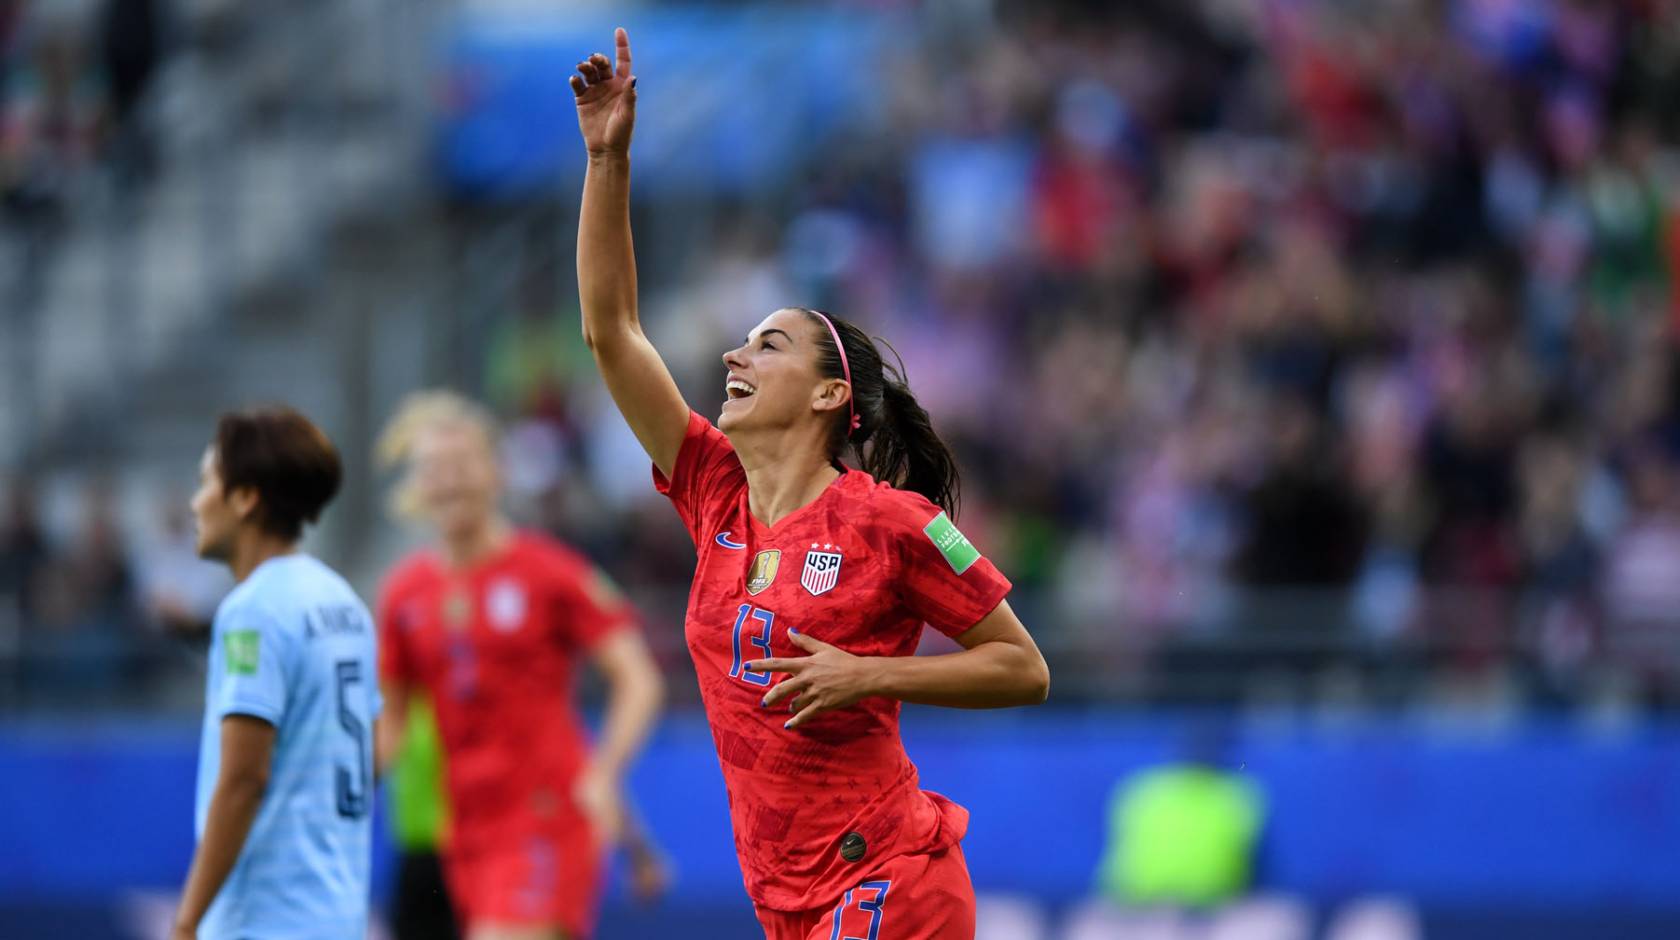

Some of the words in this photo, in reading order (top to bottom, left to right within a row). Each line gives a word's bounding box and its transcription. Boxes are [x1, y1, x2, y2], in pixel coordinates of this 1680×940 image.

[808, 554, 838, 571] USA
[729, 603, 775, 687] 13
[336, 661, 366, 818] 5
[829, 880, 891, 940] 13
